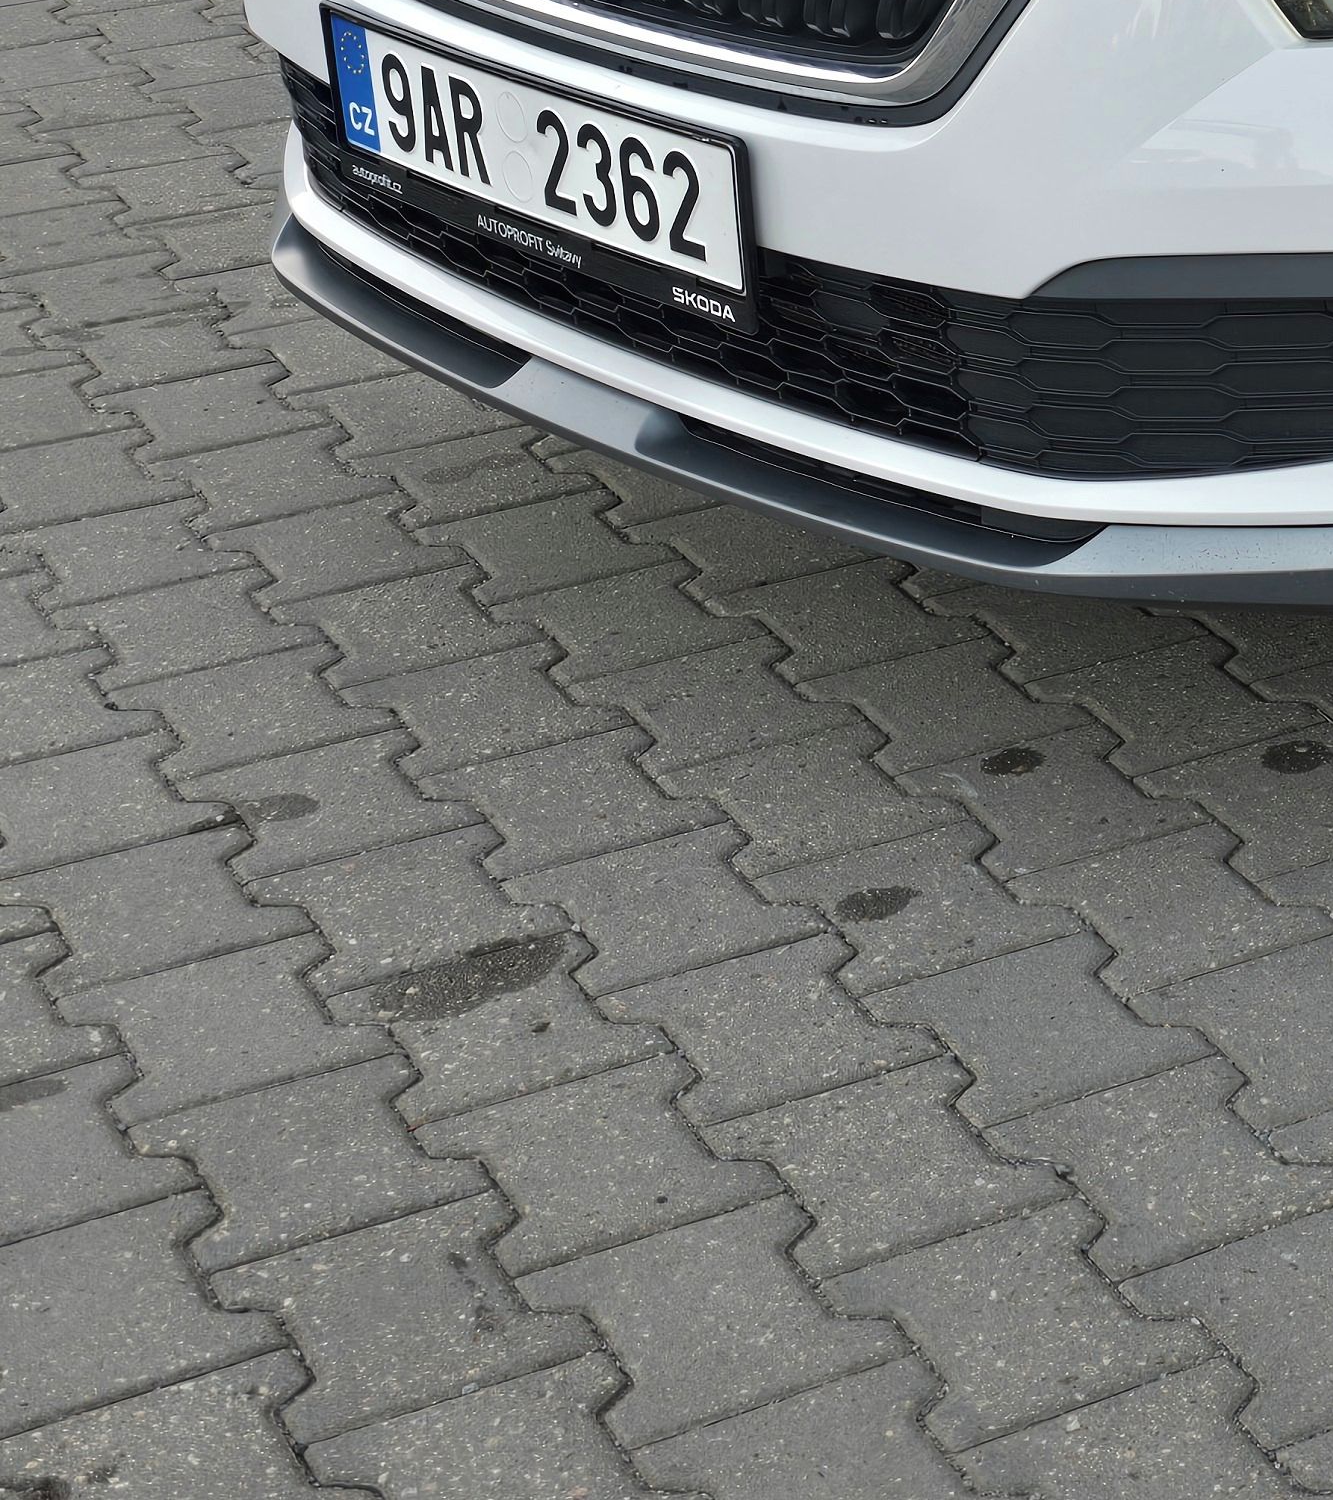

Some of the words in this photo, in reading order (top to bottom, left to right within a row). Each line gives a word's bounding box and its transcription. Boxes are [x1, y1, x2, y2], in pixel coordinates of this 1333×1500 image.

[349, 101, 375, 136] CZ
[381, 53, 492, 187] 9AR
[536, 109, 707, 263] 2362
[477, 213, 544, 252] AUTOPROFIT
